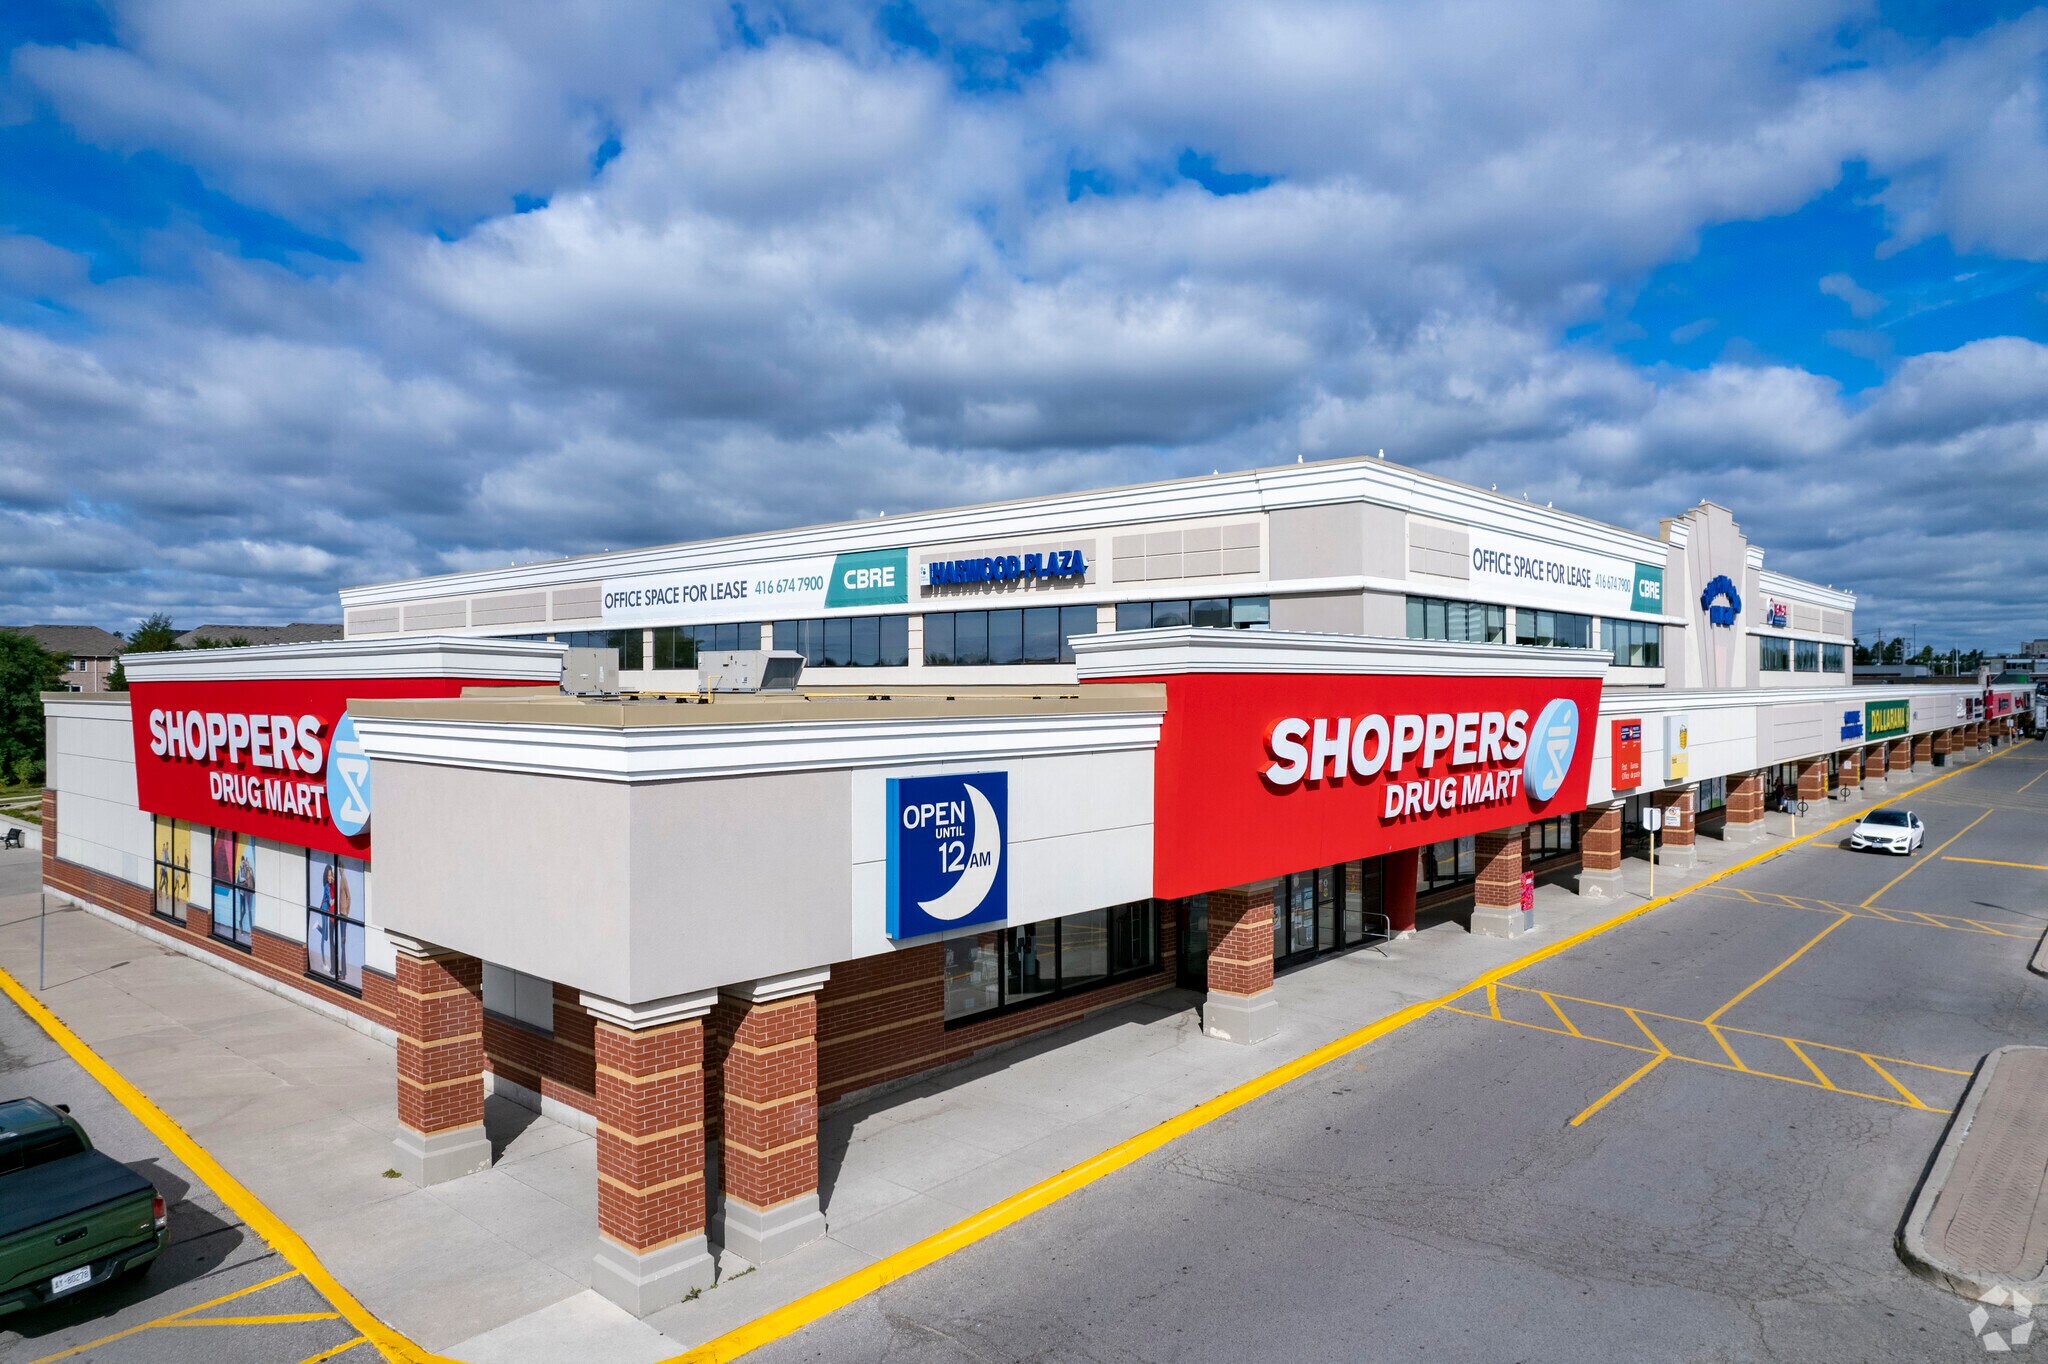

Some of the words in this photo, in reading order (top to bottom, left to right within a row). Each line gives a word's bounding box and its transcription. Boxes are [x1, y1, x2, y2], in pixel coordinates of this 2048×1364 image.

[843, 566, 895, 589] CBRE
[930, 556, 1021, 585] HARWOOD
[1024, 550, 1086, 578] PLAZA
[1473, 547, 1511, 575] OFFICE
[1514, 555, 1543, 581] SPACE
[1546, 561, 1565, 584] FOR
[1566, 566, 1591, 588] LEASE
[1595, 573, 1607, 589] 416
[1607, 575, 1618, 591] 674
[1618, 577, 1631, 593] 7900
[604, 590, 642, 609] OFFICE
[645, 586, 679, 605] SPACE
[682, 583, 708, 602] FOR
[710, 580, 748, 600] LEASE
[754, 579, 776, 595] 416
[776, 577, 796, 593] 674
[797, 575, 824, 592] 7900
[1639, 579, 1660, 600] CBRE
[1871, 707, 1905, 733] DOLLARAMA
[149, 708, 325, 774] SHOPPERS
[1263, 709, 1529, 785] SHOPPERS
[209, 771, 263, 808] DRUG
[264, 778, 325, 819] MART
[1383, 776, 1457, 819] DRUG
[1460, 769, 1523, 807] MART
[903, 800, 965, 830] OPEN
[935, 825, 965, 839] UNTIL
[938, 840, 965, 873] 12
[969, 851, 991, 869] AM
